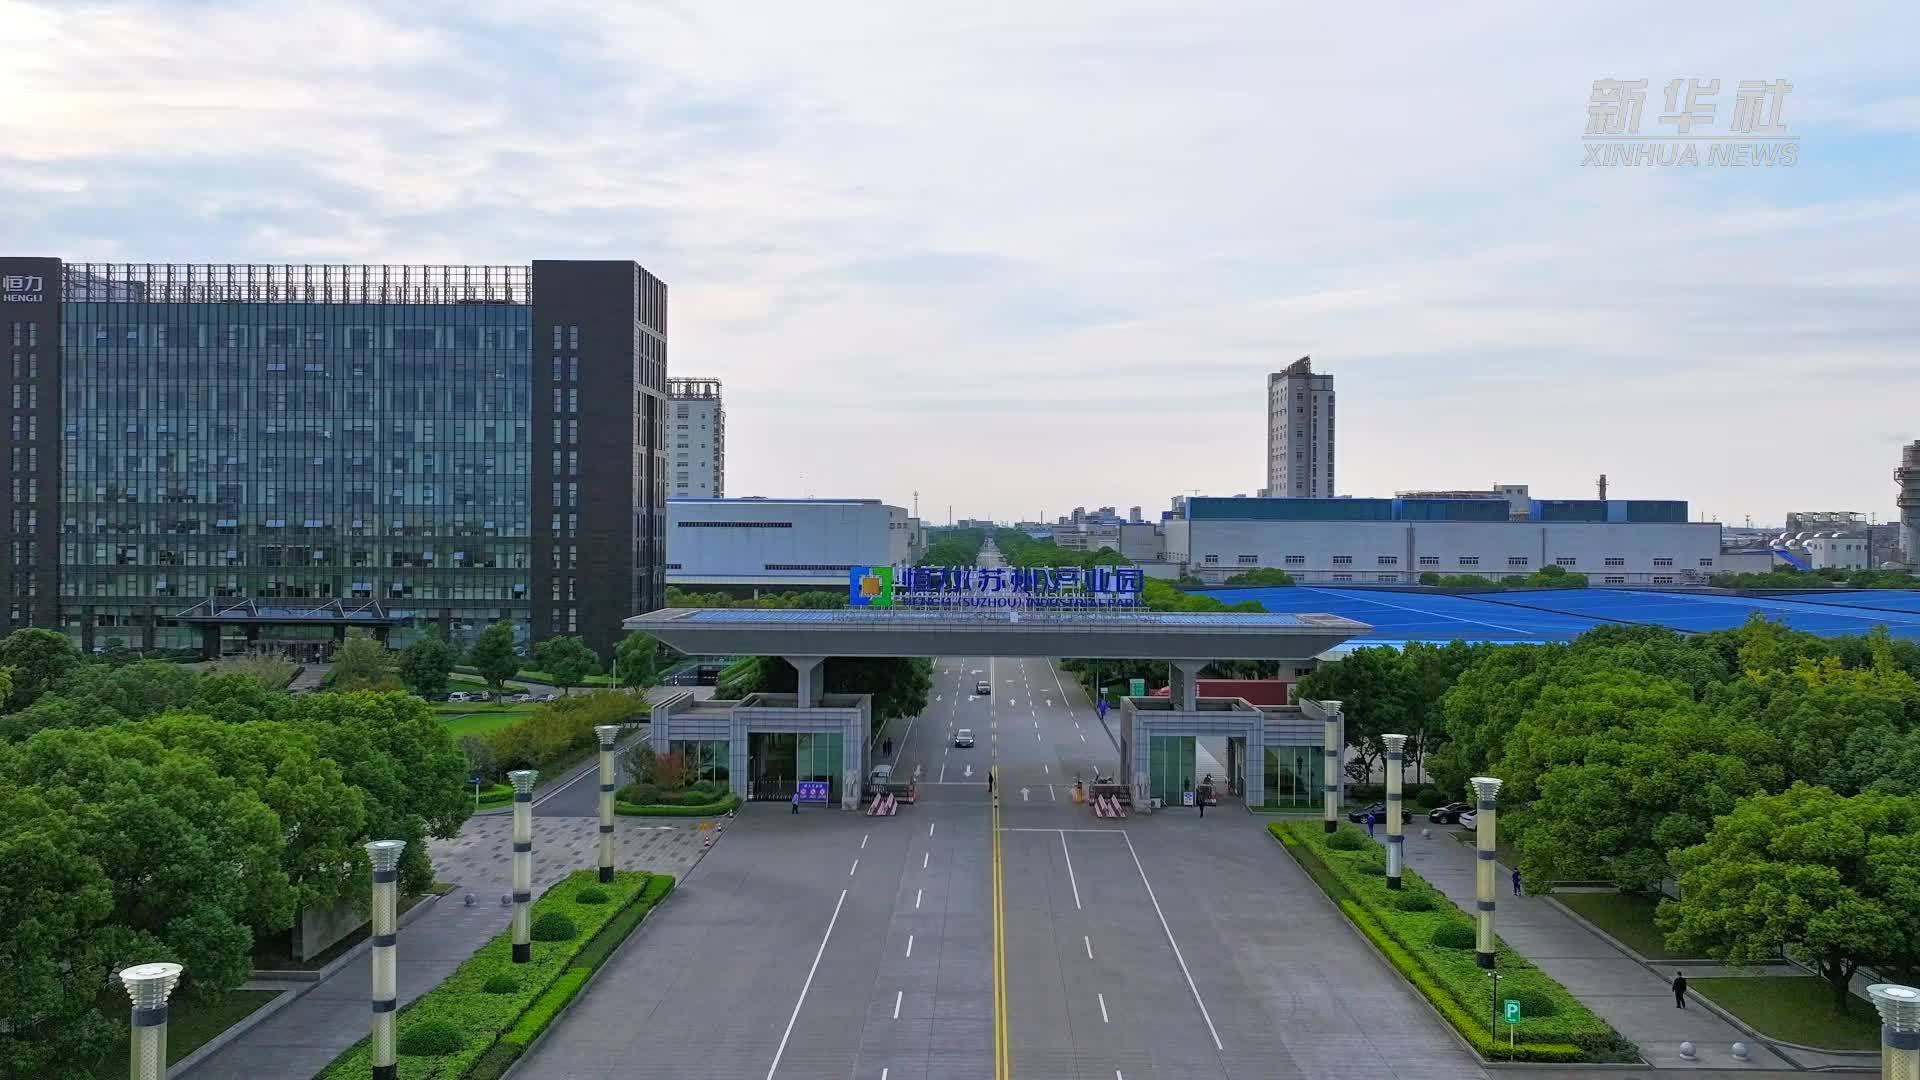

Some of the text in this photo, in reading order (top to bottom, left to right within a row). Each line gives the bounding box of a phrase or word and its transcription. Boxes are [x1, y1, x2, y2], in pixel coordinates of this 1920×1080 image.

[3, 275, 43, 292] 恒力
[3, 294, 43, 302] HENGLI
[1507, 1004, 1518, 1018] P
